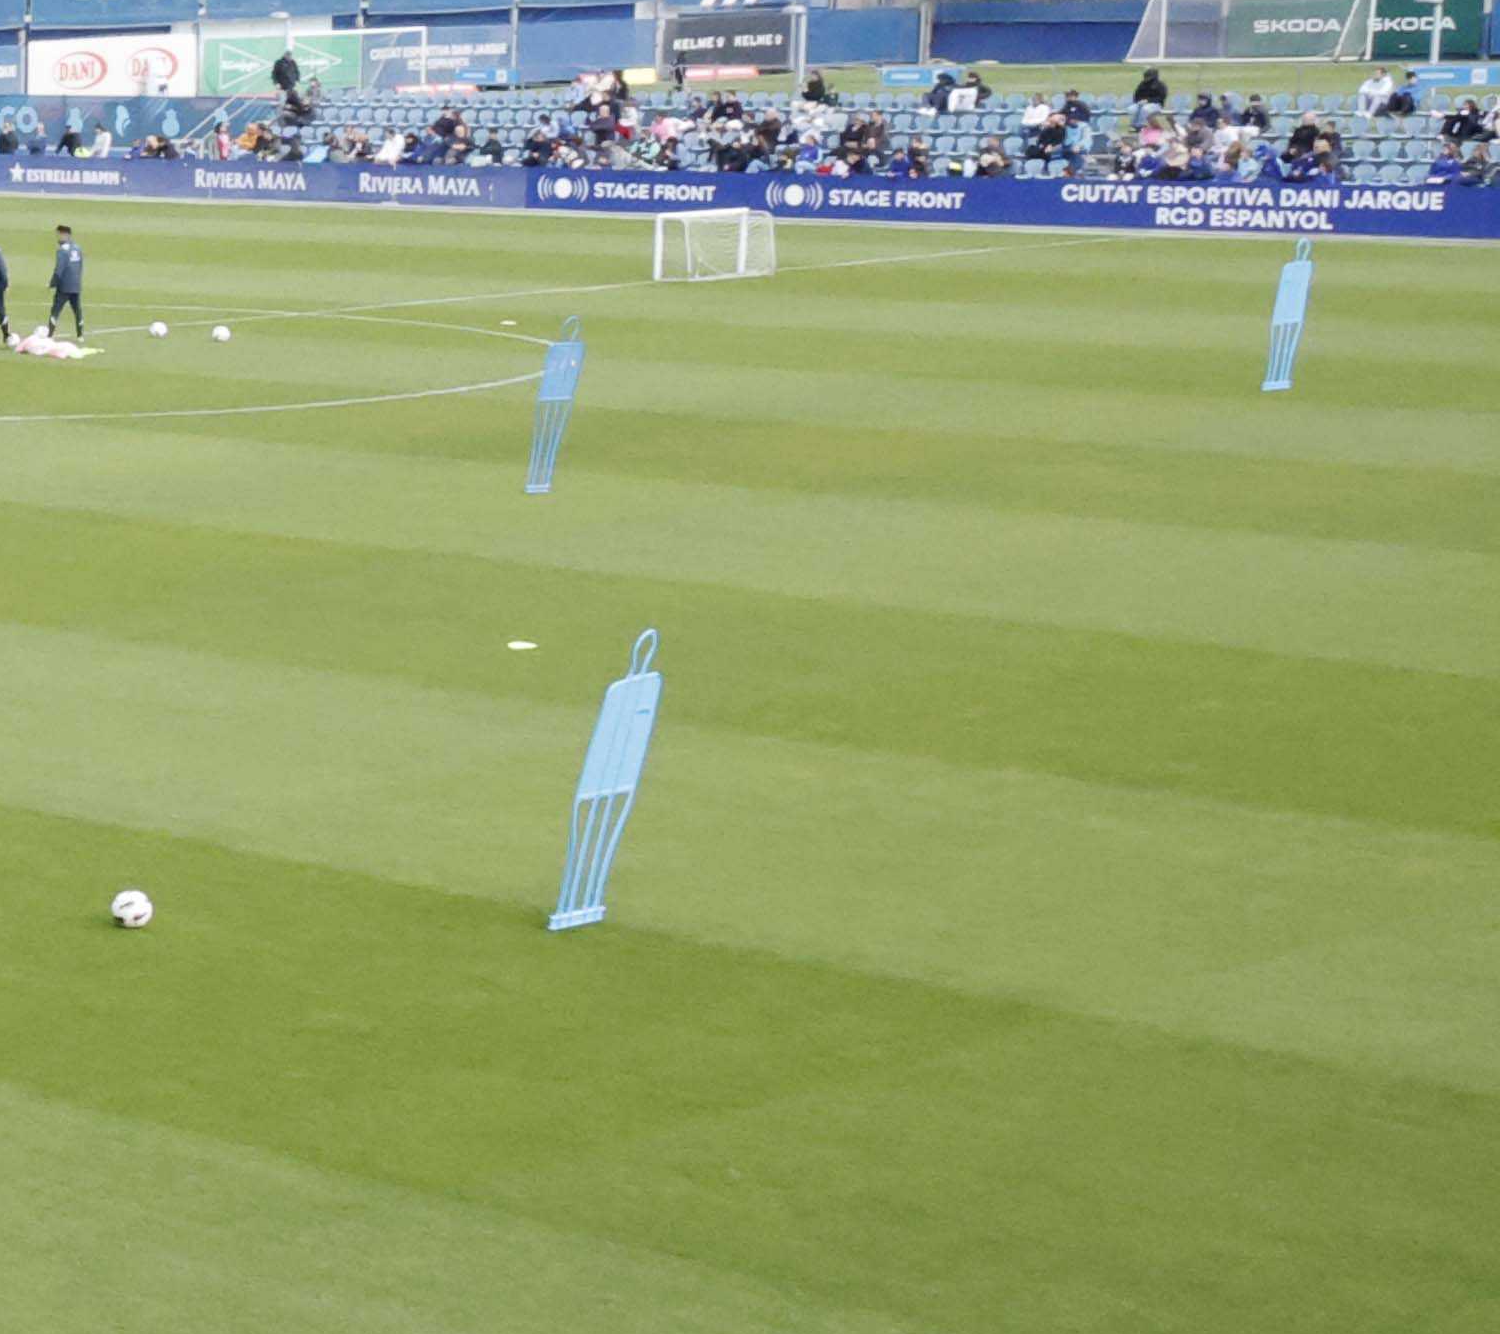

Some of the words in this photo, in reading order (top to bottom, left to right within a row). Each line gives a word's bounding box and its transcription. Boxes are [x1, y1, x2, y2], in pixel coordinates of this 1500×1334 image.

[60, 60, 95, 80] DANI
[195, 168, 253, 189] RIVIERA
[258, 170, 306, 191] MAYA
[359, 172, 423, 195] RIVIERA
[427, 175, 480, 196] MAYA
[593, 182, 650, 201] STAGE
[653, 184, 716, 202] FRONT
[828, 188, 891, 208] STAGE
[895, 190, 965, 210] FRONT
[1061, 183, 1142, 204] CIUTAT
[1147, 185, 1274, 207] ESPORTIVA
[1280, 187, 1338, 208] DANI
[1344, 189, 1444, 211] JARQUE
[1156, 206, 1204, 227] RCD
[1209, 208, 1332, 230] ESPANYOL
